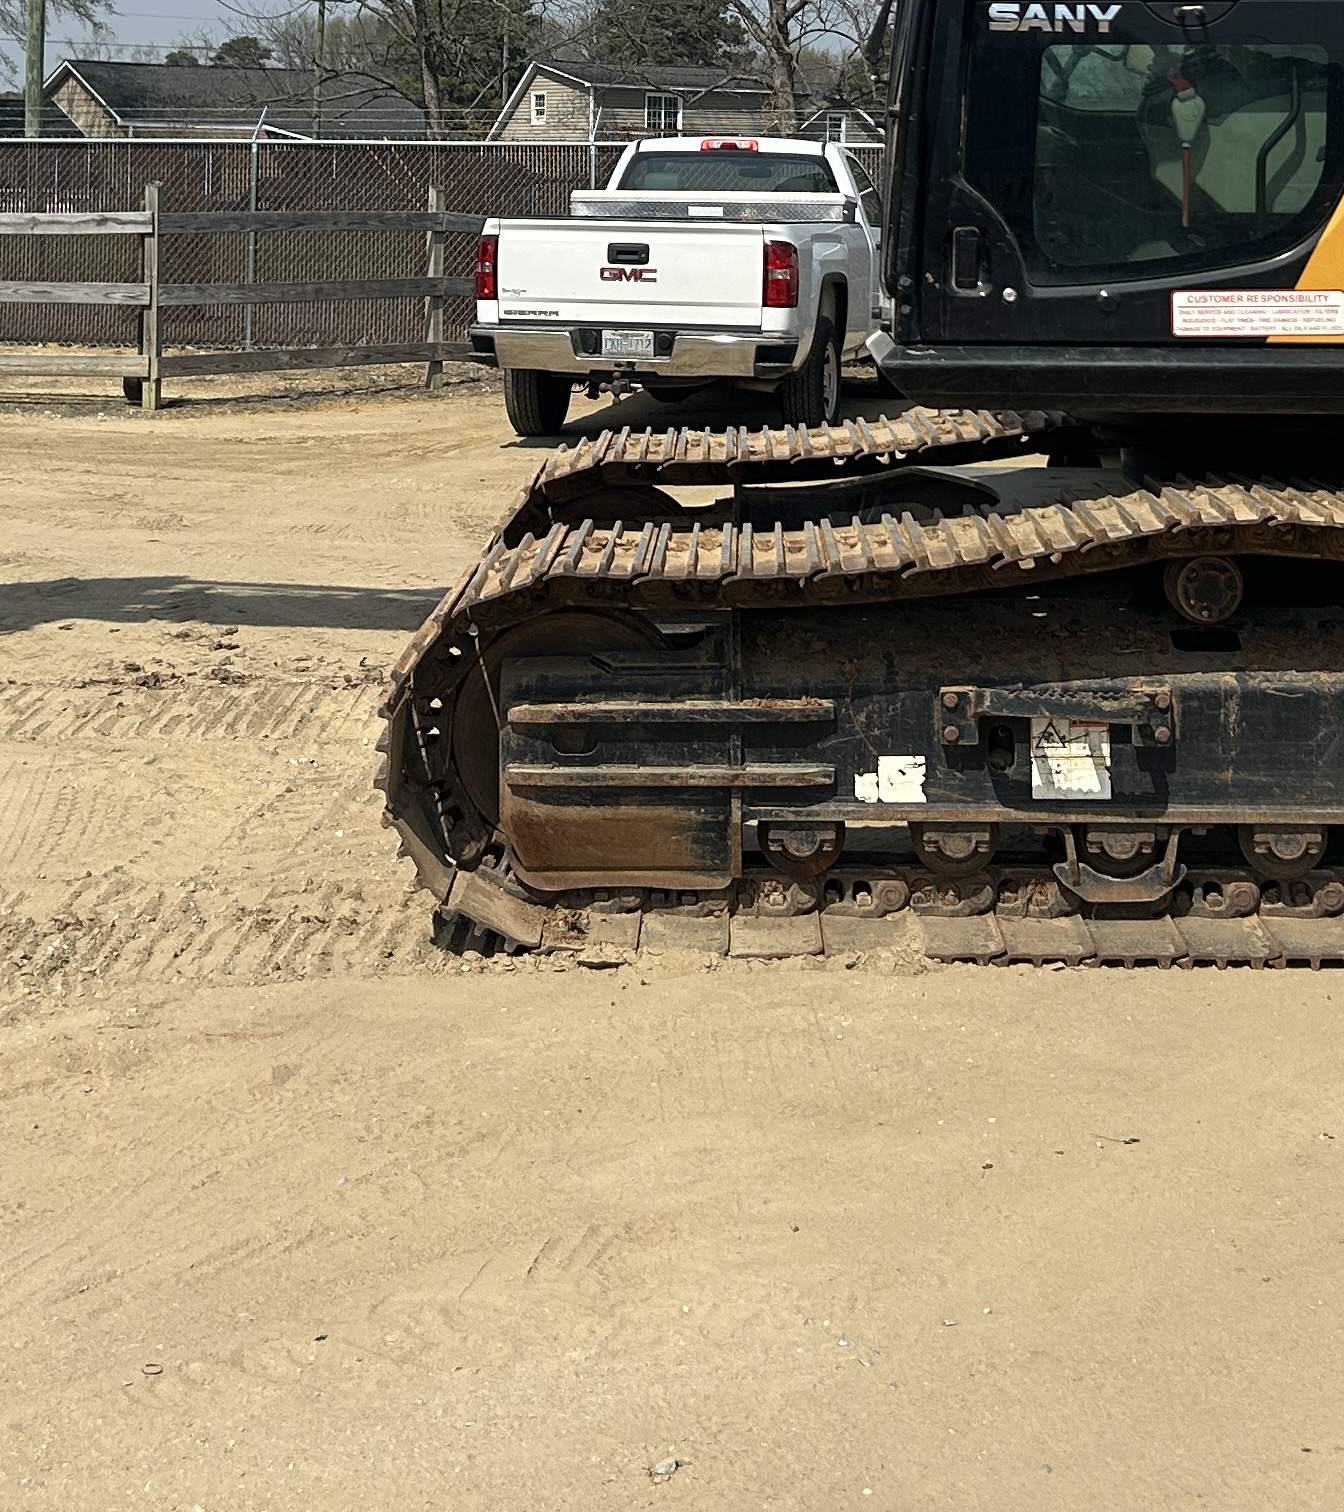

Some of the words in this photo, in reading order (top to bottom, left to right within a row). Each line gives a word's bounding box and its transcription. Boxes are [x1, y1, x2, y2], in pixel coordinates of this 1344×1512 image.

[988, 3, 1122, 33] SANY
[600, 267, 657, 283] GMC
[1187, 294, 1244, 303] CUSTOMER
[1246, 294, 1330, 303] RESPONSIBILITY
[503, 309, 560, 317] SIERRA
